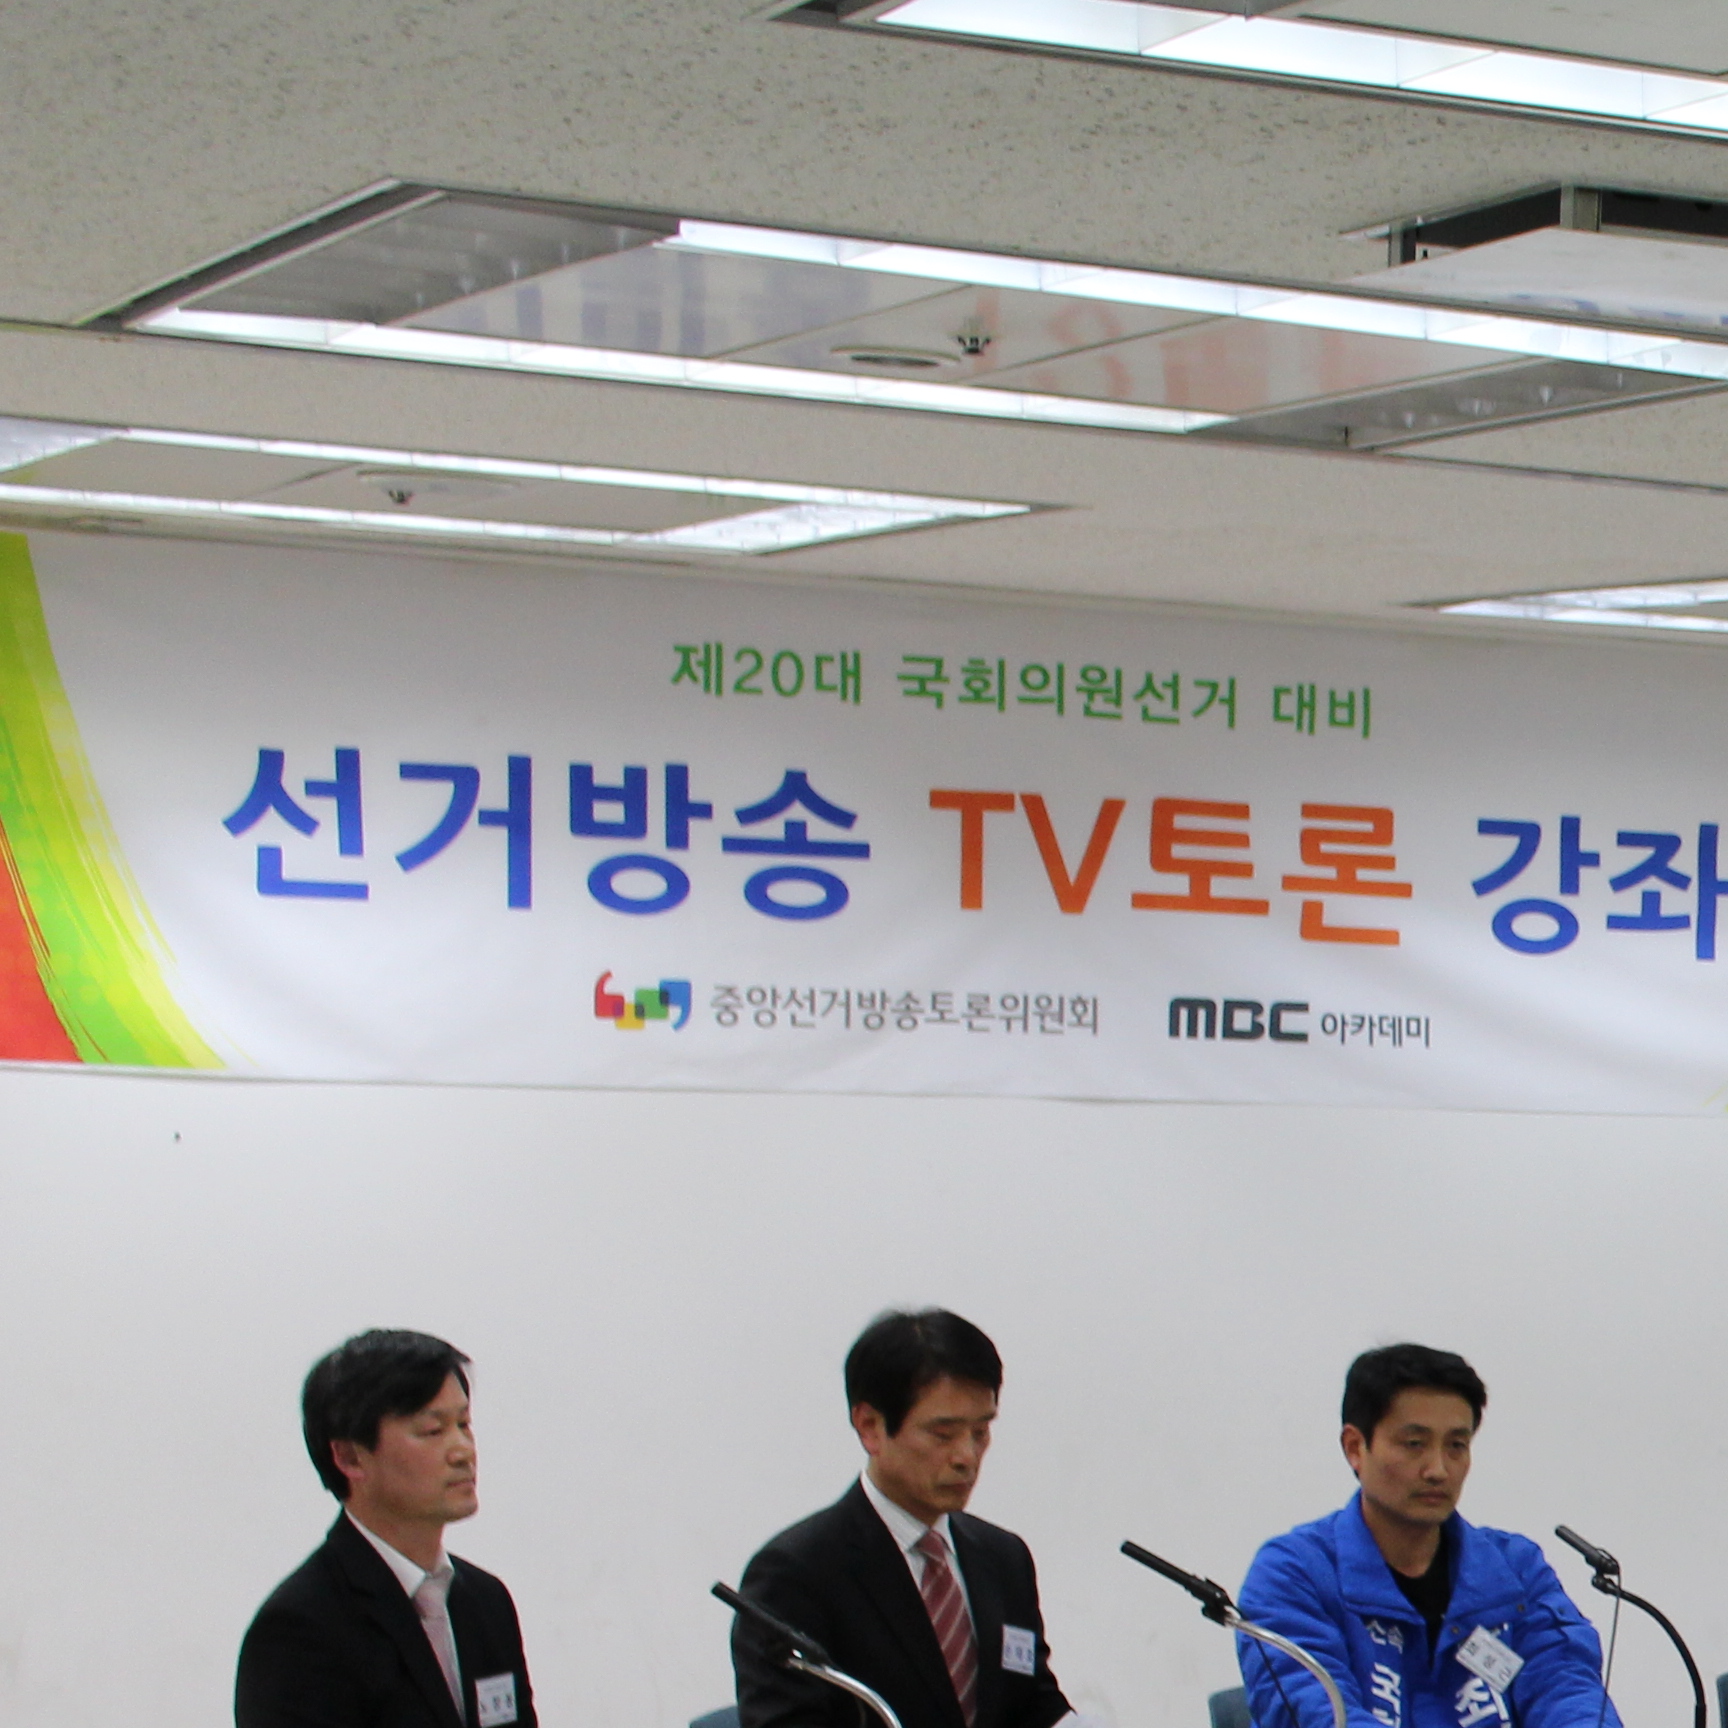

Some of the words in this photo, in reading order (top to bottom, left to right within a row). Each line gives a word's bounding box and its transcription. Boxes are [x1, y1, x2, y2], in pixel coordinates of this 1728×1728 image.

[670, 641, 862, 706] 제20대
[896, 655, 1237, 729] 국회의원선거
[1271, 683, 1373, 739] 대비
[222, 747, 870, 921] 선거방송
[929, 789, 1414, 947] TV토론
[709, 984, 1099, 1036] 중앙선거방송토론위원회
[1168, 996, 1310, 1044] MBC
[1320, 1012, 1431, 1049] 아카데미
